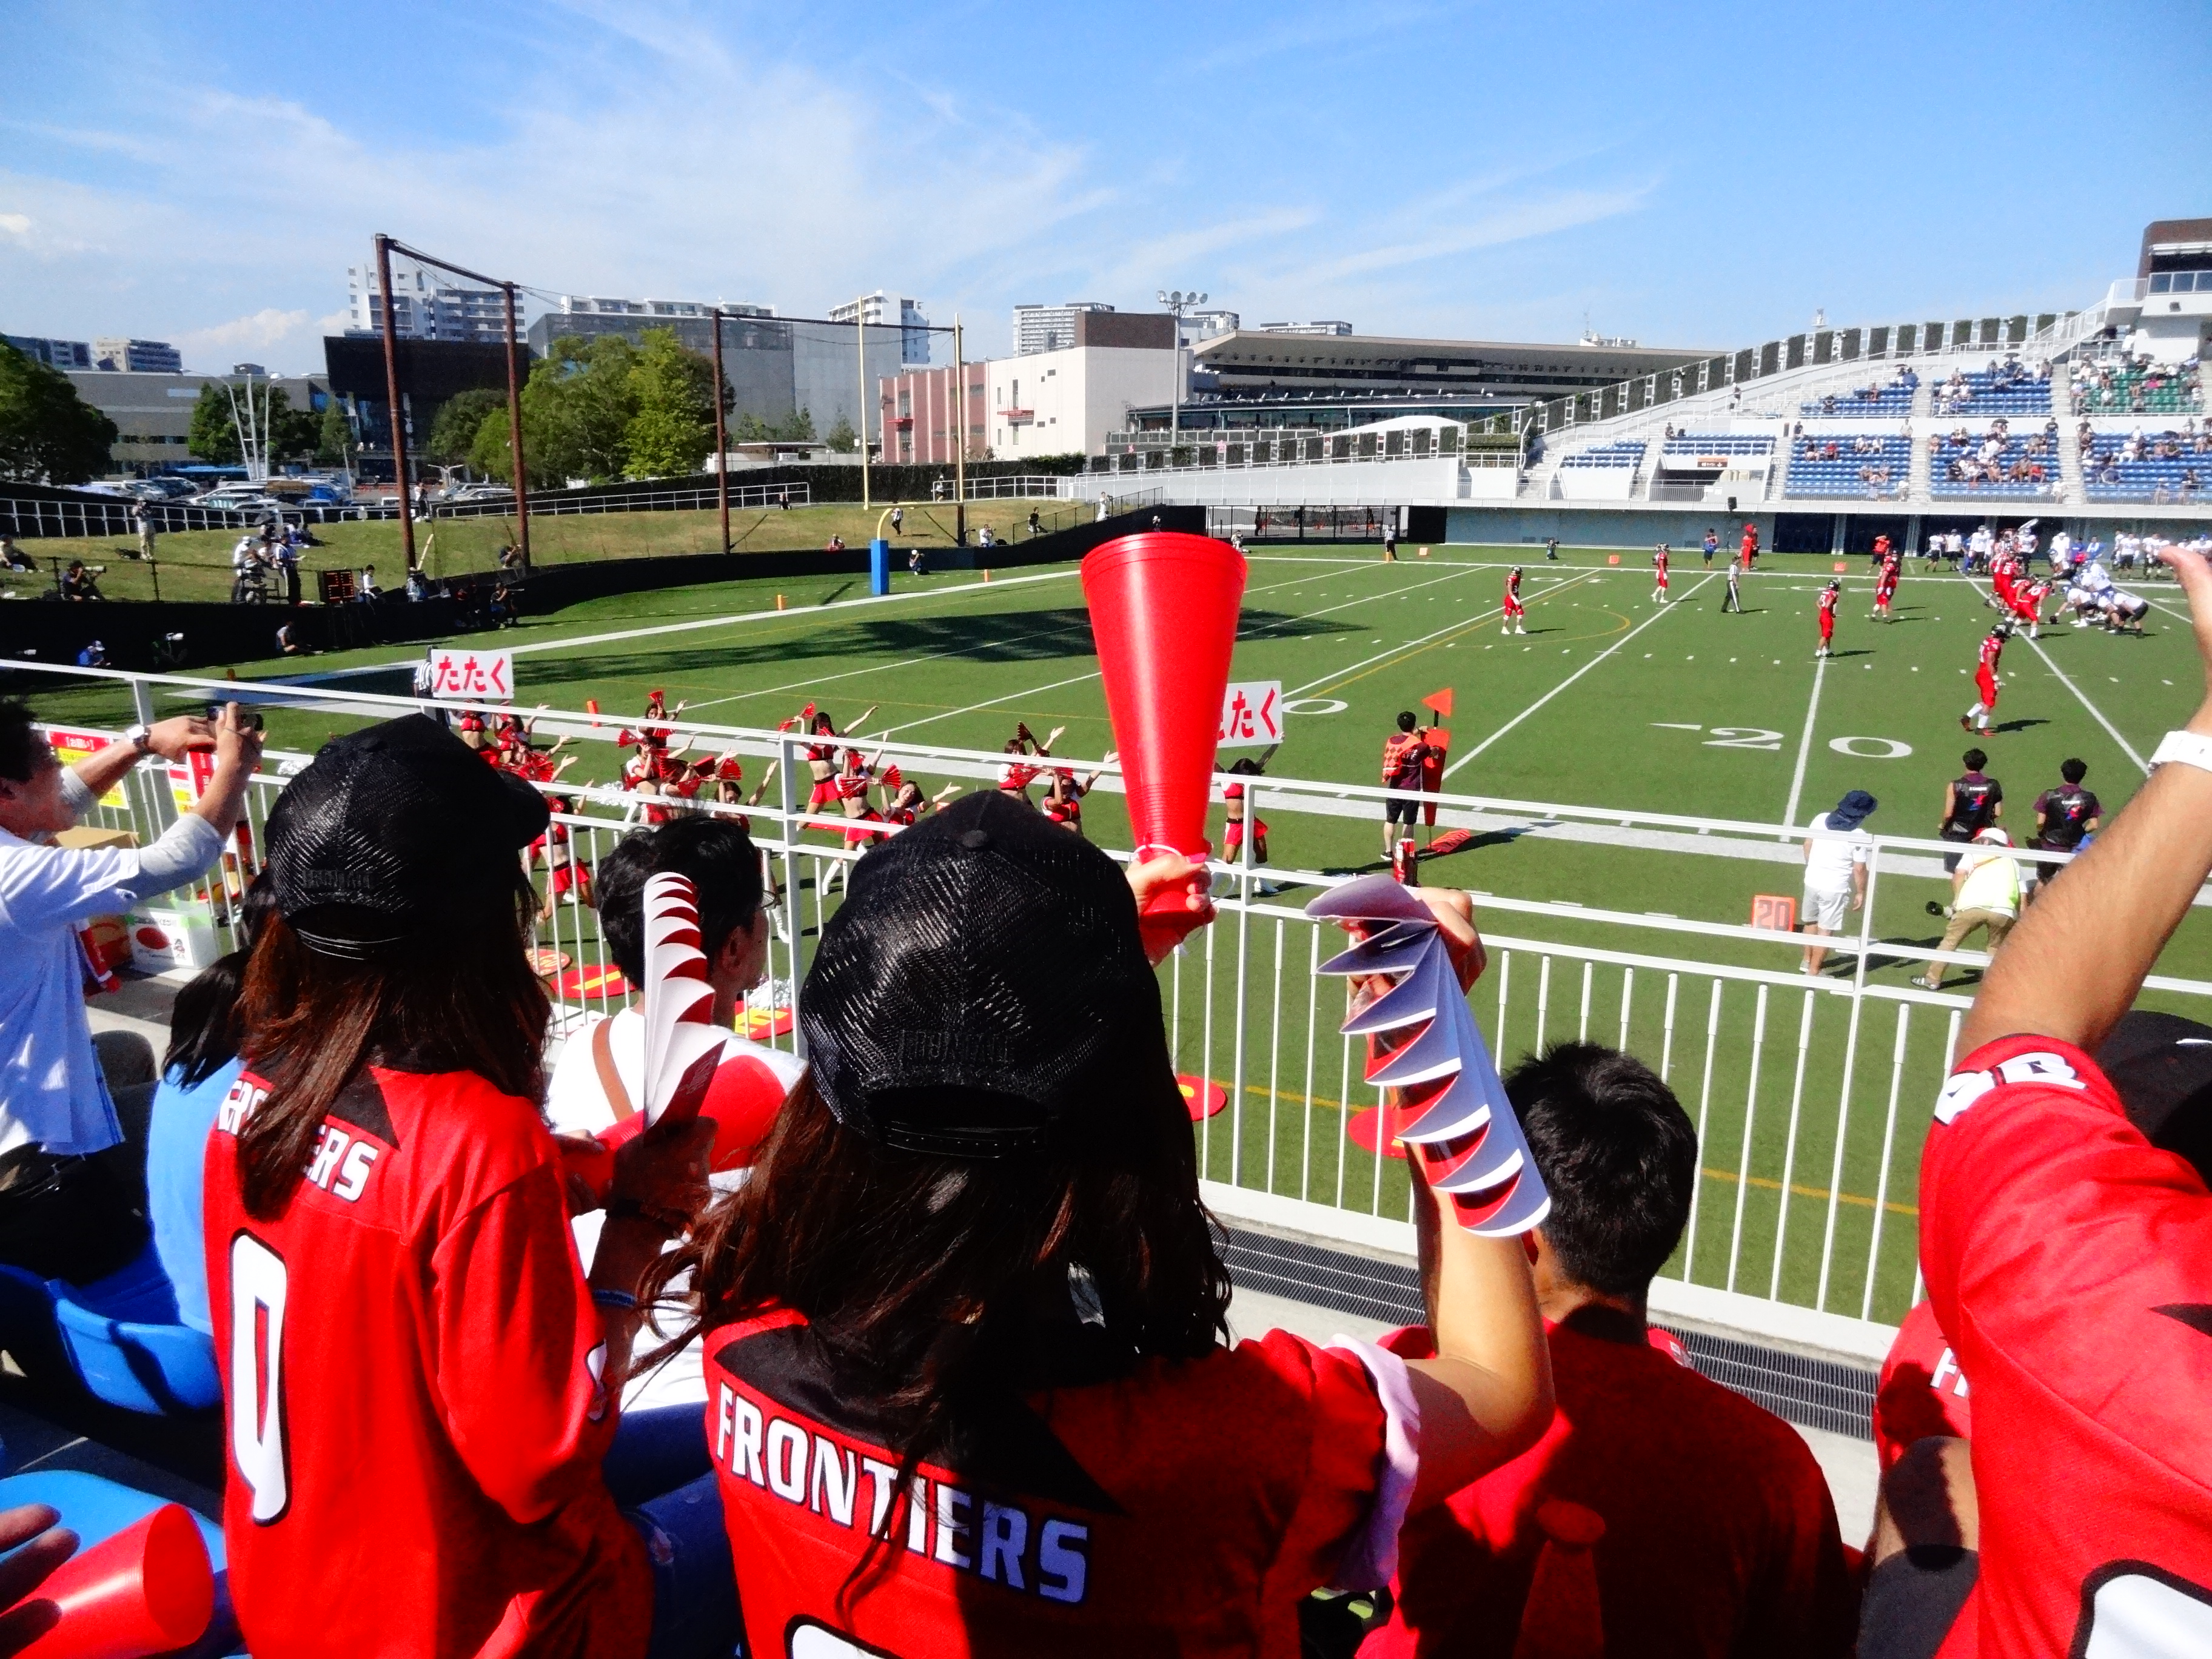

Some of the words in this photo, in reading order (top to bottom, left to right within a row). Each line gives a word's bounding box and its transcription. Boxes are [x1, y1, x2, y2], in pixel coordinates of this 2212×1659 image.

[432, 655, 506, 695] たたく
[1218, 687, 1276, 740] たく
[1756, 899, 1791, 931] 20
[715, 1379, 1089, 1606] FRONTIERS
